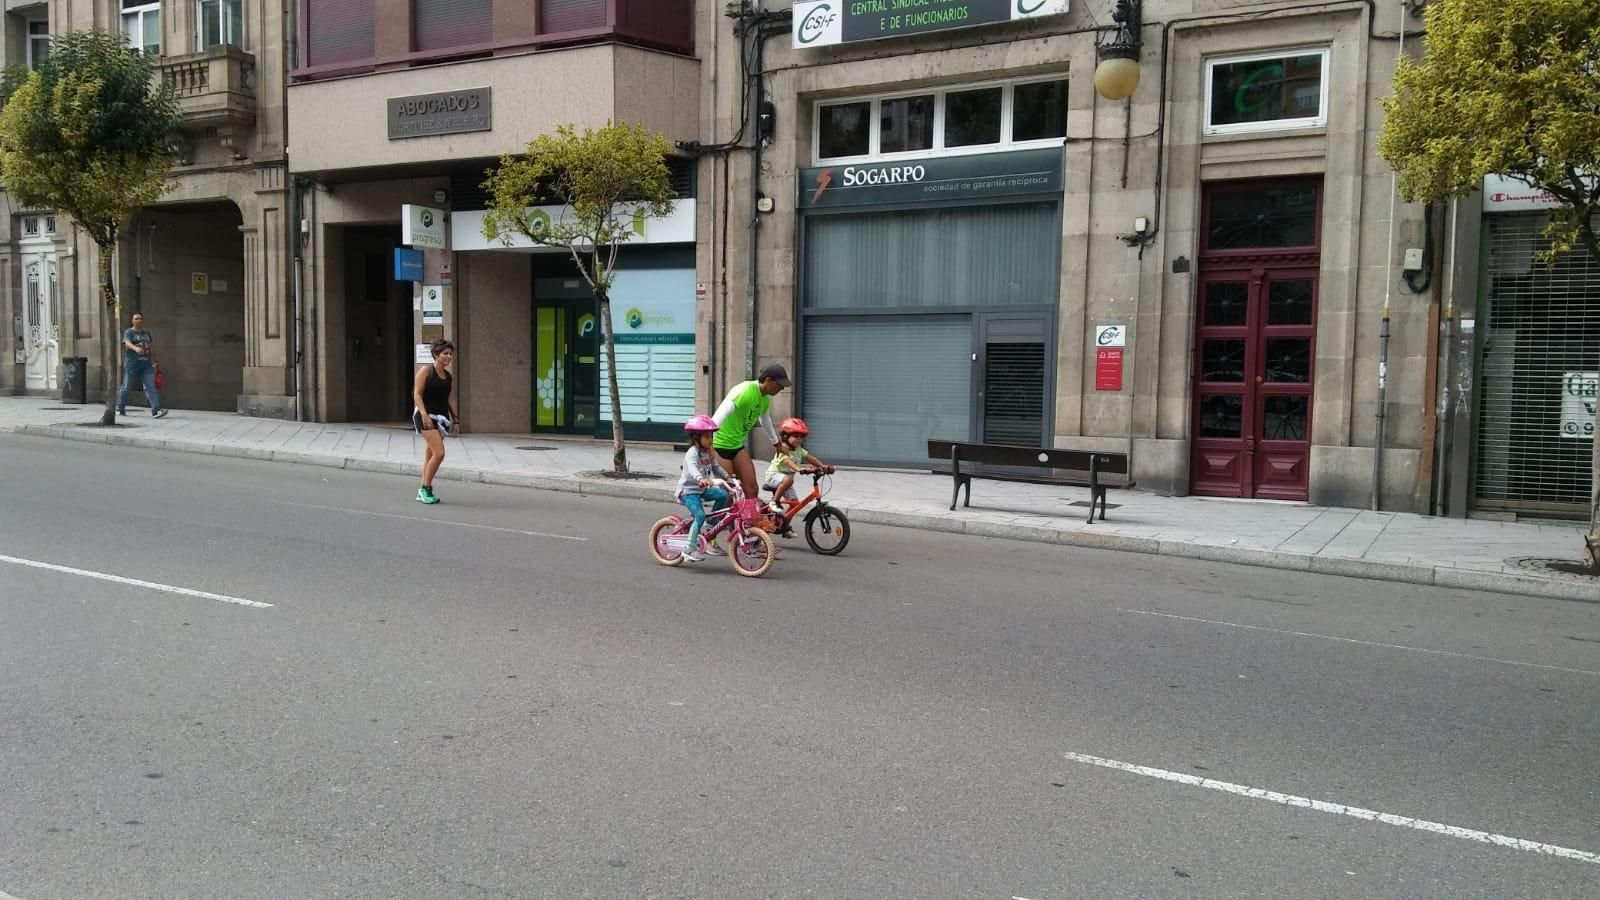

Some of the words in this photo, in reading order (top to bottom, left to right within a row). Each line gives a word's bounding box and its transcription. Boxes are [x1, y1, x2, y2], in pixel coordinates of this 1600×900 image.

[851, 0, 888, 16] CENTRAL
[880, 17, 886, 31] E
[890, 15, 900, 29] DE
[905, 6, 969, 27] FUNCIONARIOS
[398, 95, 479, 117] ABOGADOS
[843, 165, 925, 186] SOGARPO
[923, 182, 959, 193] sociedad
[961, 182, 971, 190] de
